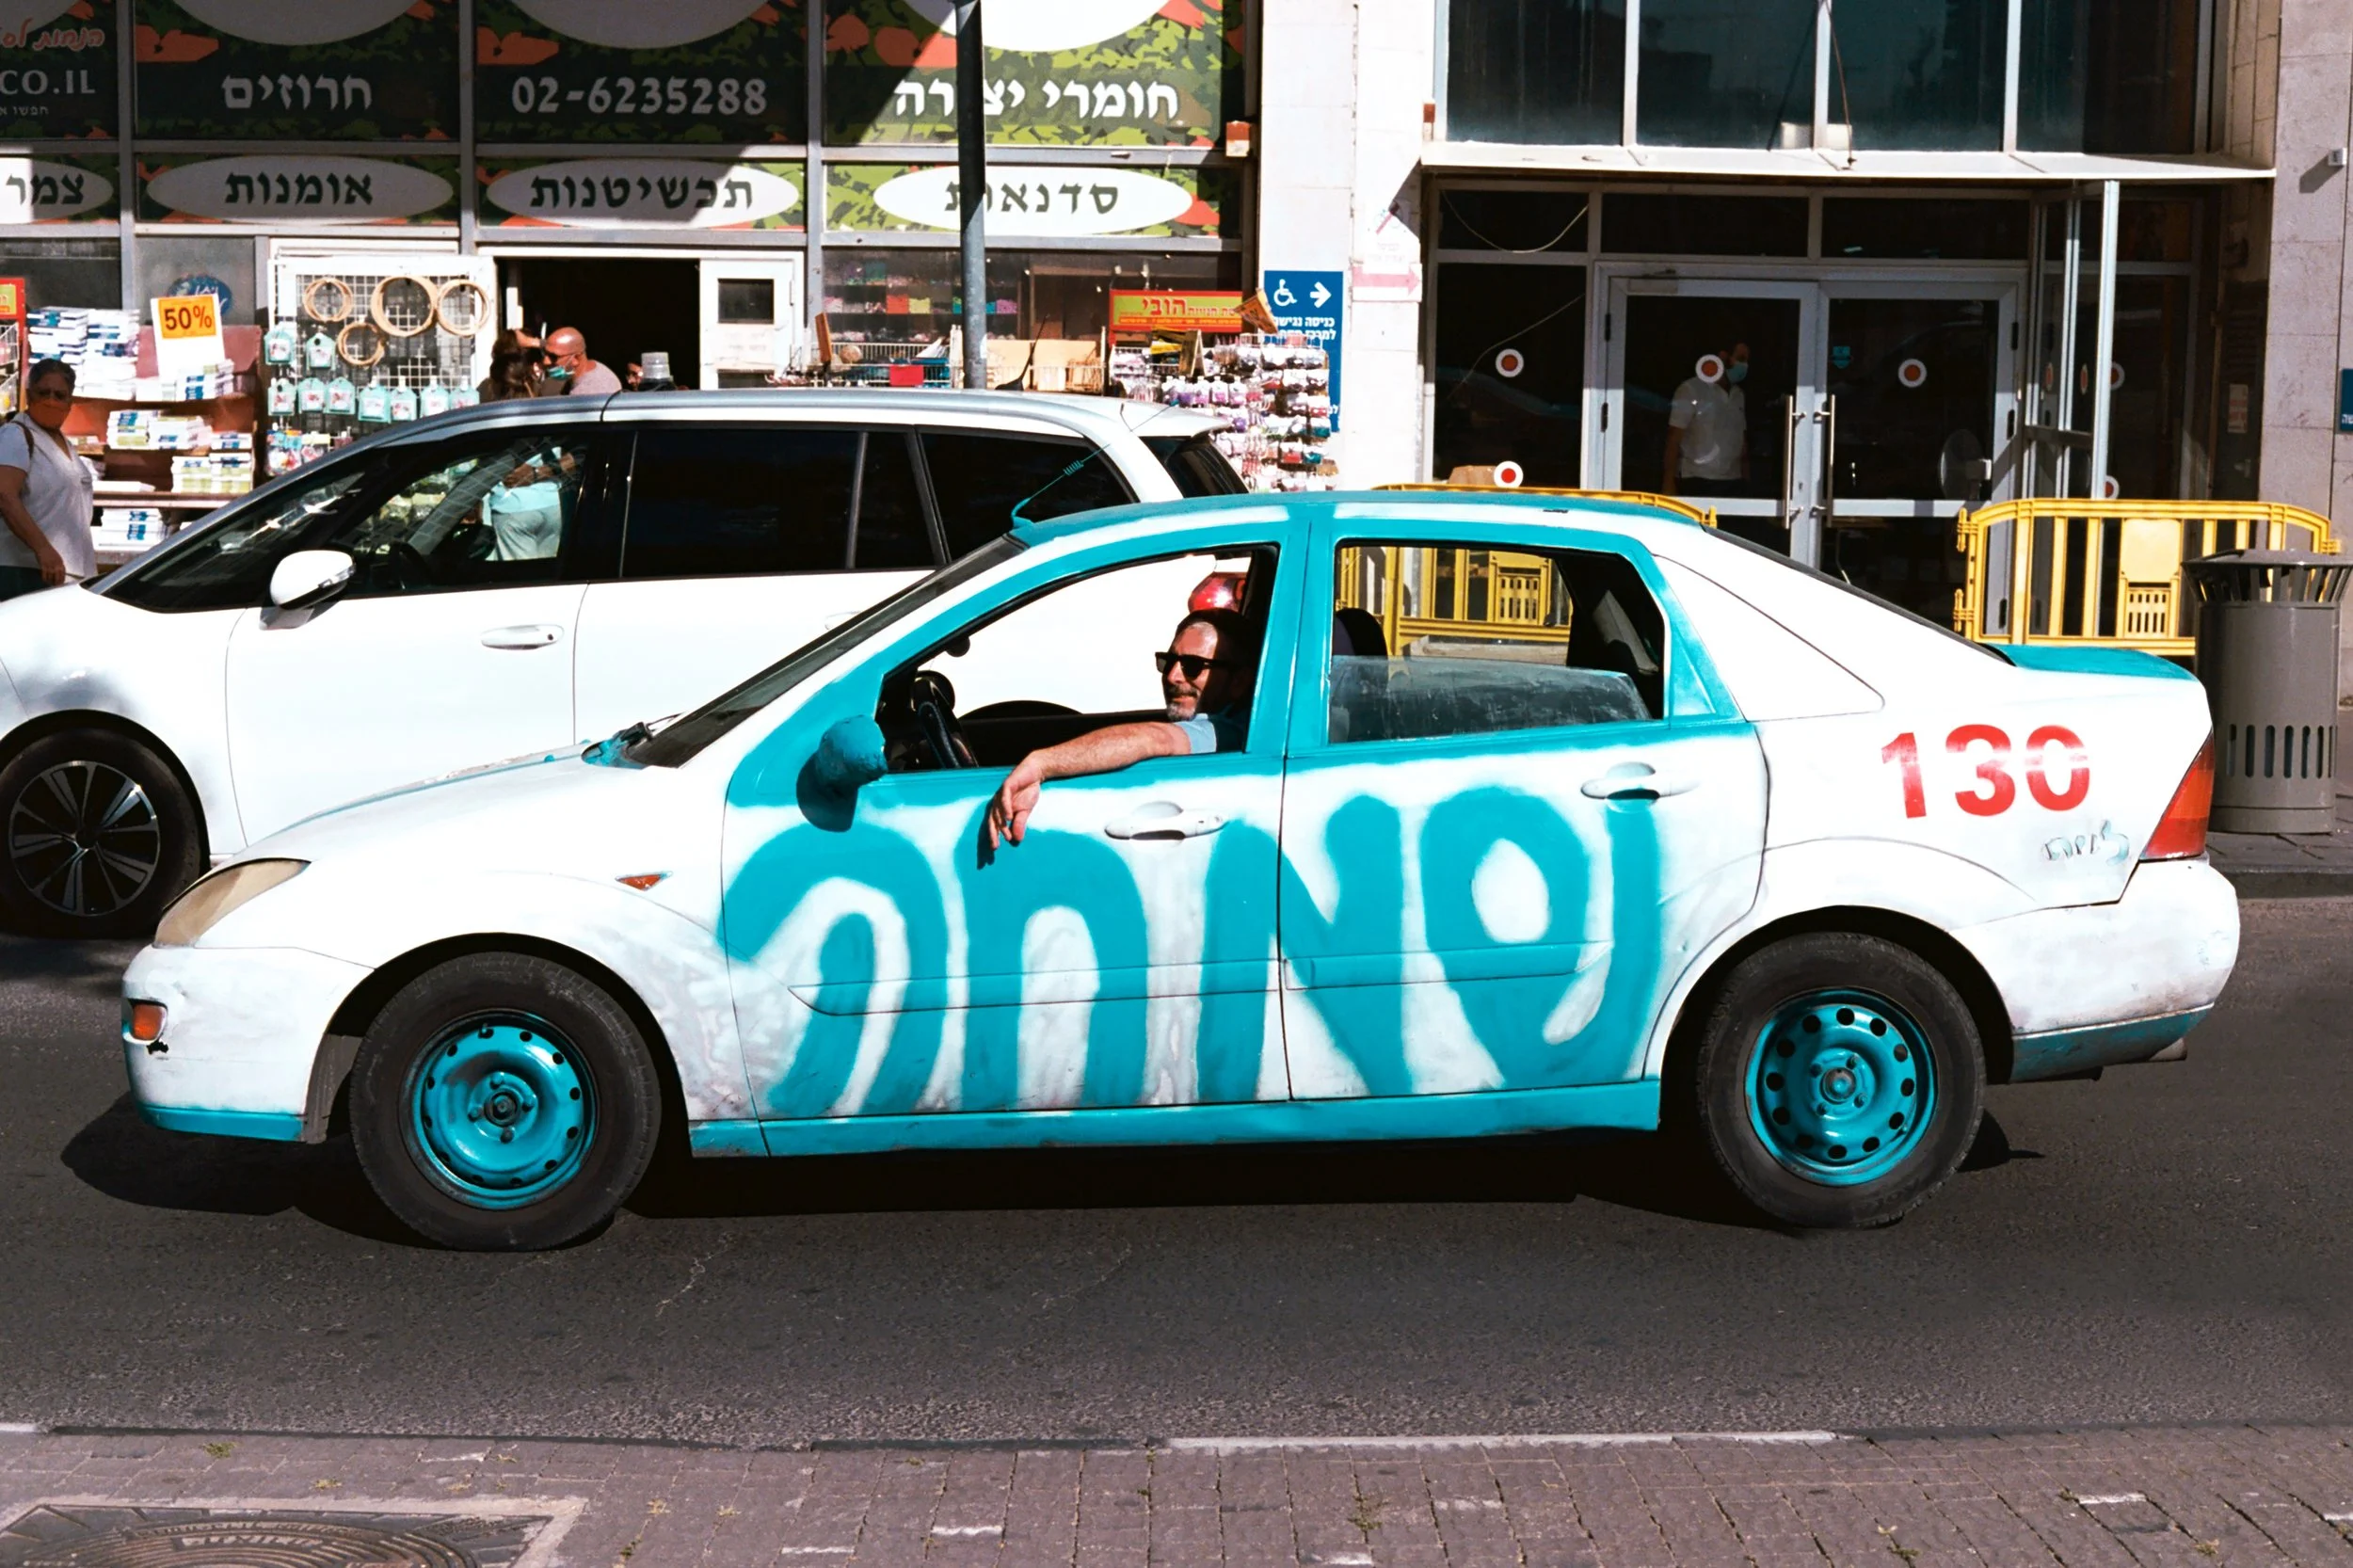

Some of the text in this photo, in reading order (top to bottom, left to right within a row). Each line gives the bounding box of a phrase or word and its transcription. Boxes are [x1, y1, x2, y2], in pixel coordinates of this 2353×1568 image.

[221, 73, 373, 111] חרוזים
[511, 75, 768, 115] 02-6235288
[894, 78, 1178, 119] חומרי יצרה
[6, 172, 86, 205] צמר
[224, 172, 374, 205] אומנות
[530, 174, 753, 209] תכשיטנות
[164, 305, 213, 330] 50%
[1142, 298, 1186, 315] הובי
[1881, 723, 2091, 819] 130
